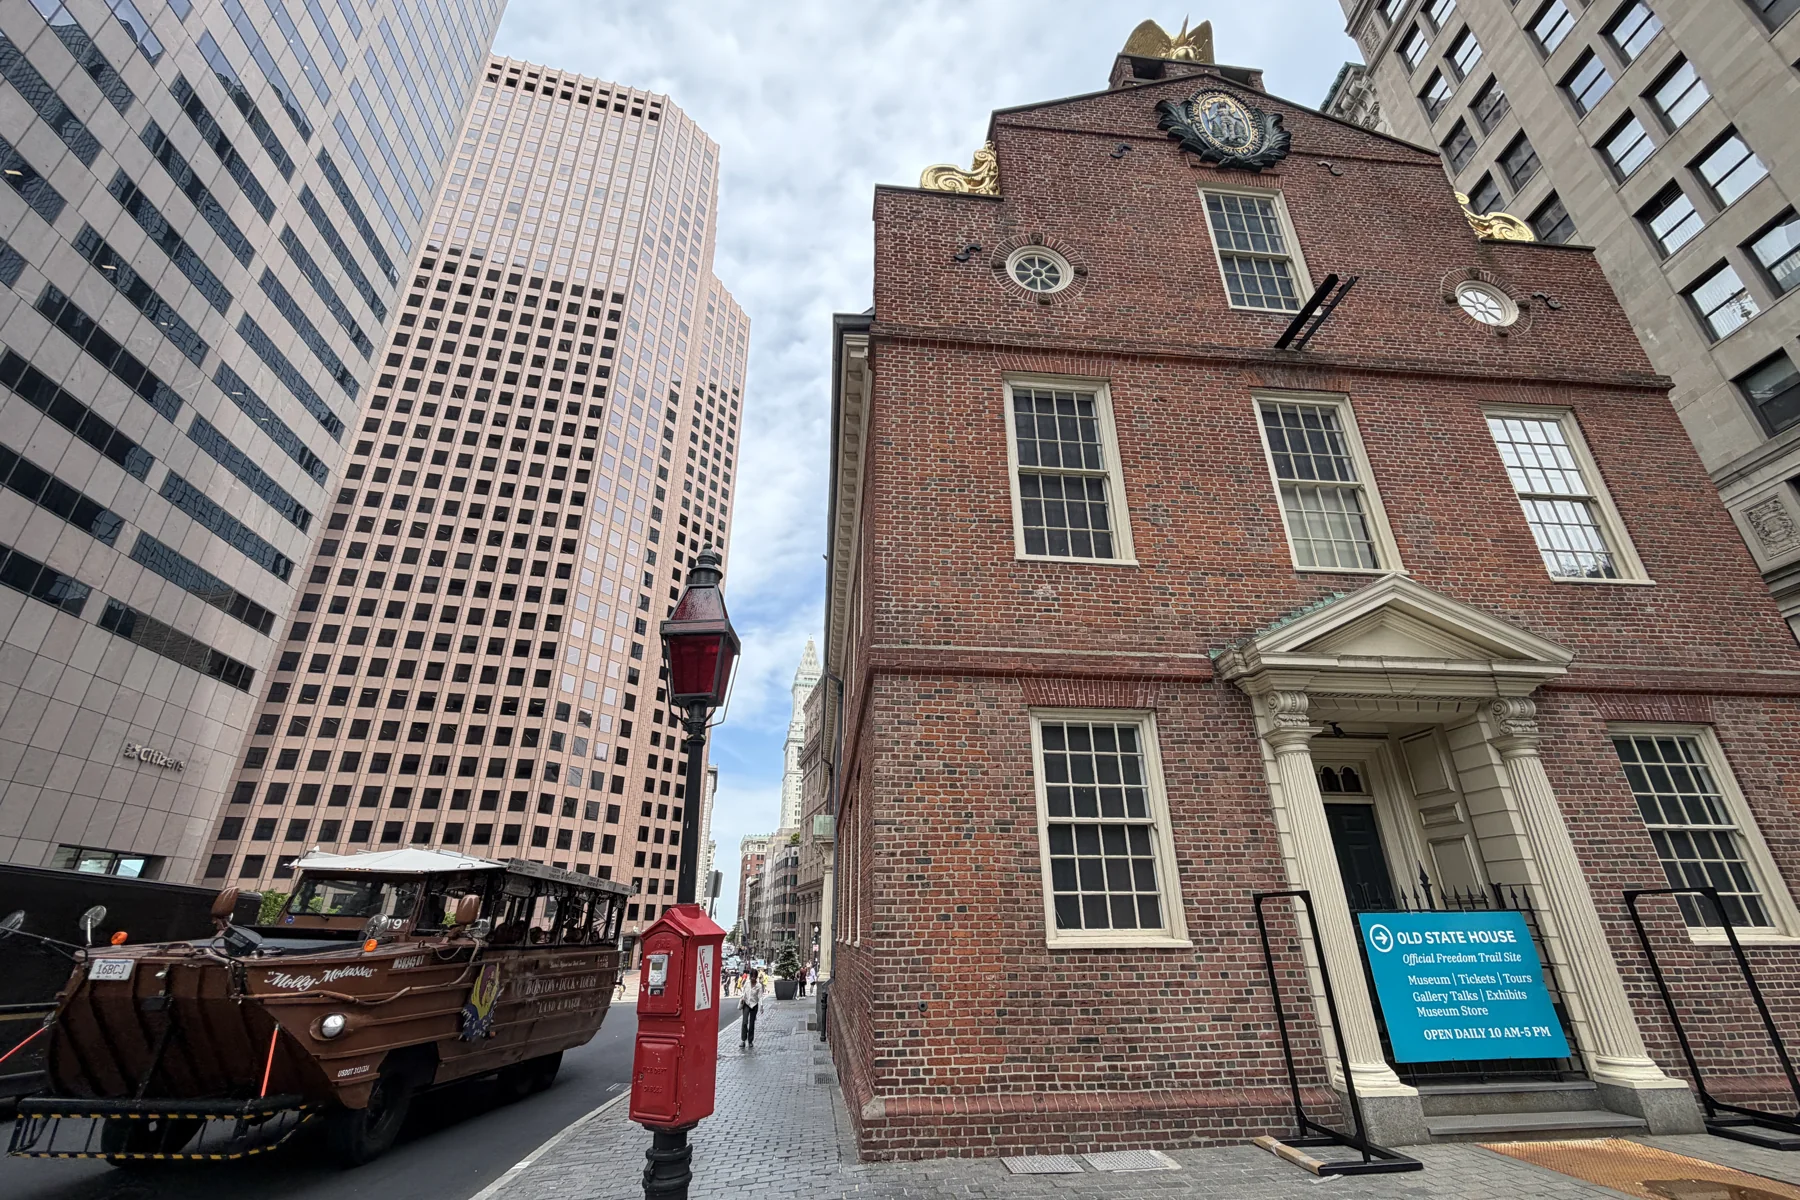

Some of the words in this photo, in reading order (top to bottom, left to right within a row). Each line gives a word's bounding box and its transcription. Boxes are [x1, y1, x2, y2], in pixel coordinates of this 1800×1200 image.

[138, 747, 186, 771] Citizens
[1397, 931, 1423, 945] OLD
[1425, 931, 1467, 944] STATE
[1467, 930, 1517, 943] HOUSE
[701, 948, 710, 978] FIRE
[1402, 953, 1435, 966] Official
[1436, 952, 1478, 963] Freedom
[1478, 952, 1502, 963] Trail
[1503, 951, 1522, 962] Site
[1408, 975, 1451, 985] Museum
[1457, 973, 1496, 984] Tickets
[1502, 972, 1533, 984] Tours
[1412, 991, 1448, 1004] Gallery
[1449, 990, 1479, 1001] Talks
[1486, 989, 1528, 1000] Exhibits
[1416, 1006, 1460, 1017] Museum
[1460, 1005, 1489, 1016] Store
[1423, 1029, 1453, 1040] OPEN
[1454, 1027, 1486, 1039] DAILY
[1488, 1027, 1502, 1038] 10
[1504, 1026, 1532, 1038] AM-5
[1532, 1026, 1552, 1037] PM
